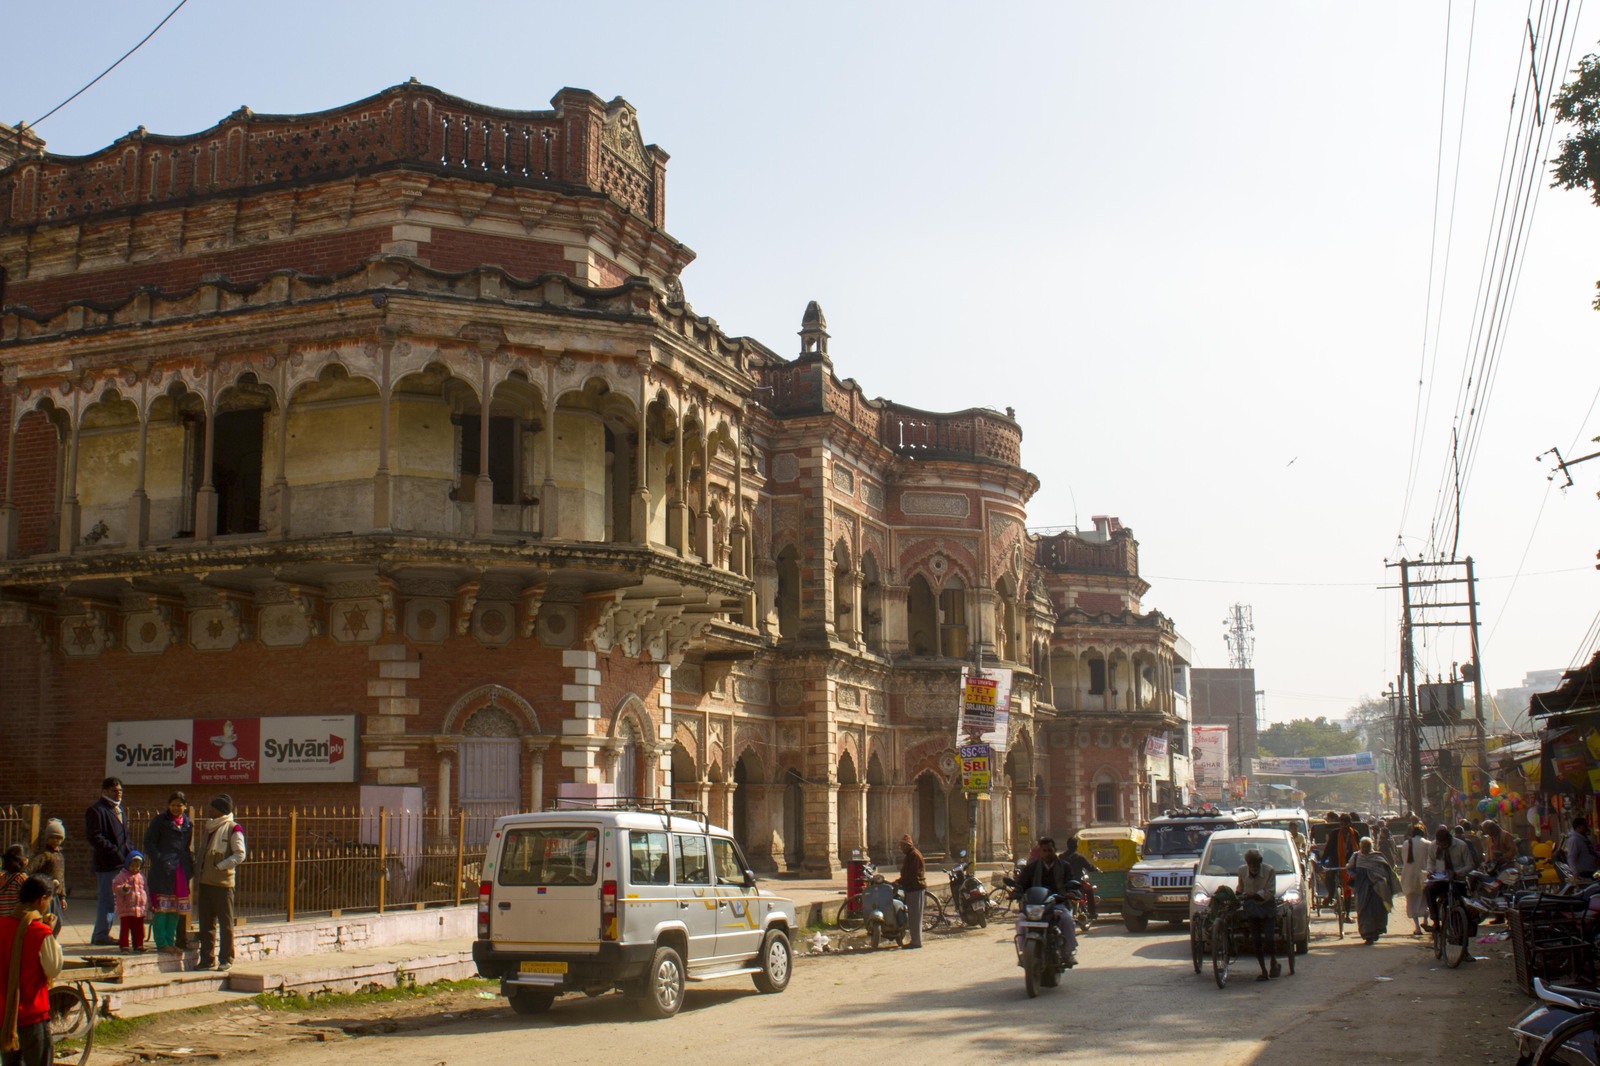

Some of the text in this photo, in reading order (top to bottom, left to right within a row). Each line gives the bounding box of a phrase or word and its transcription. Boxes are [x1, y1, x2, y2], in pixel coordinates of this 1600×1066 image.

[970, 686, 990, 694] TET
[967, 694, 994, 703] CTET
[175, 748, 187, 759] ply
[330, 744, 343, 754] ply
[961, 747, 977, 758] SSC
[195, 757, 256, 771] पंचरत्न मन्दिर
[963, 761, 986, 772] SBI
